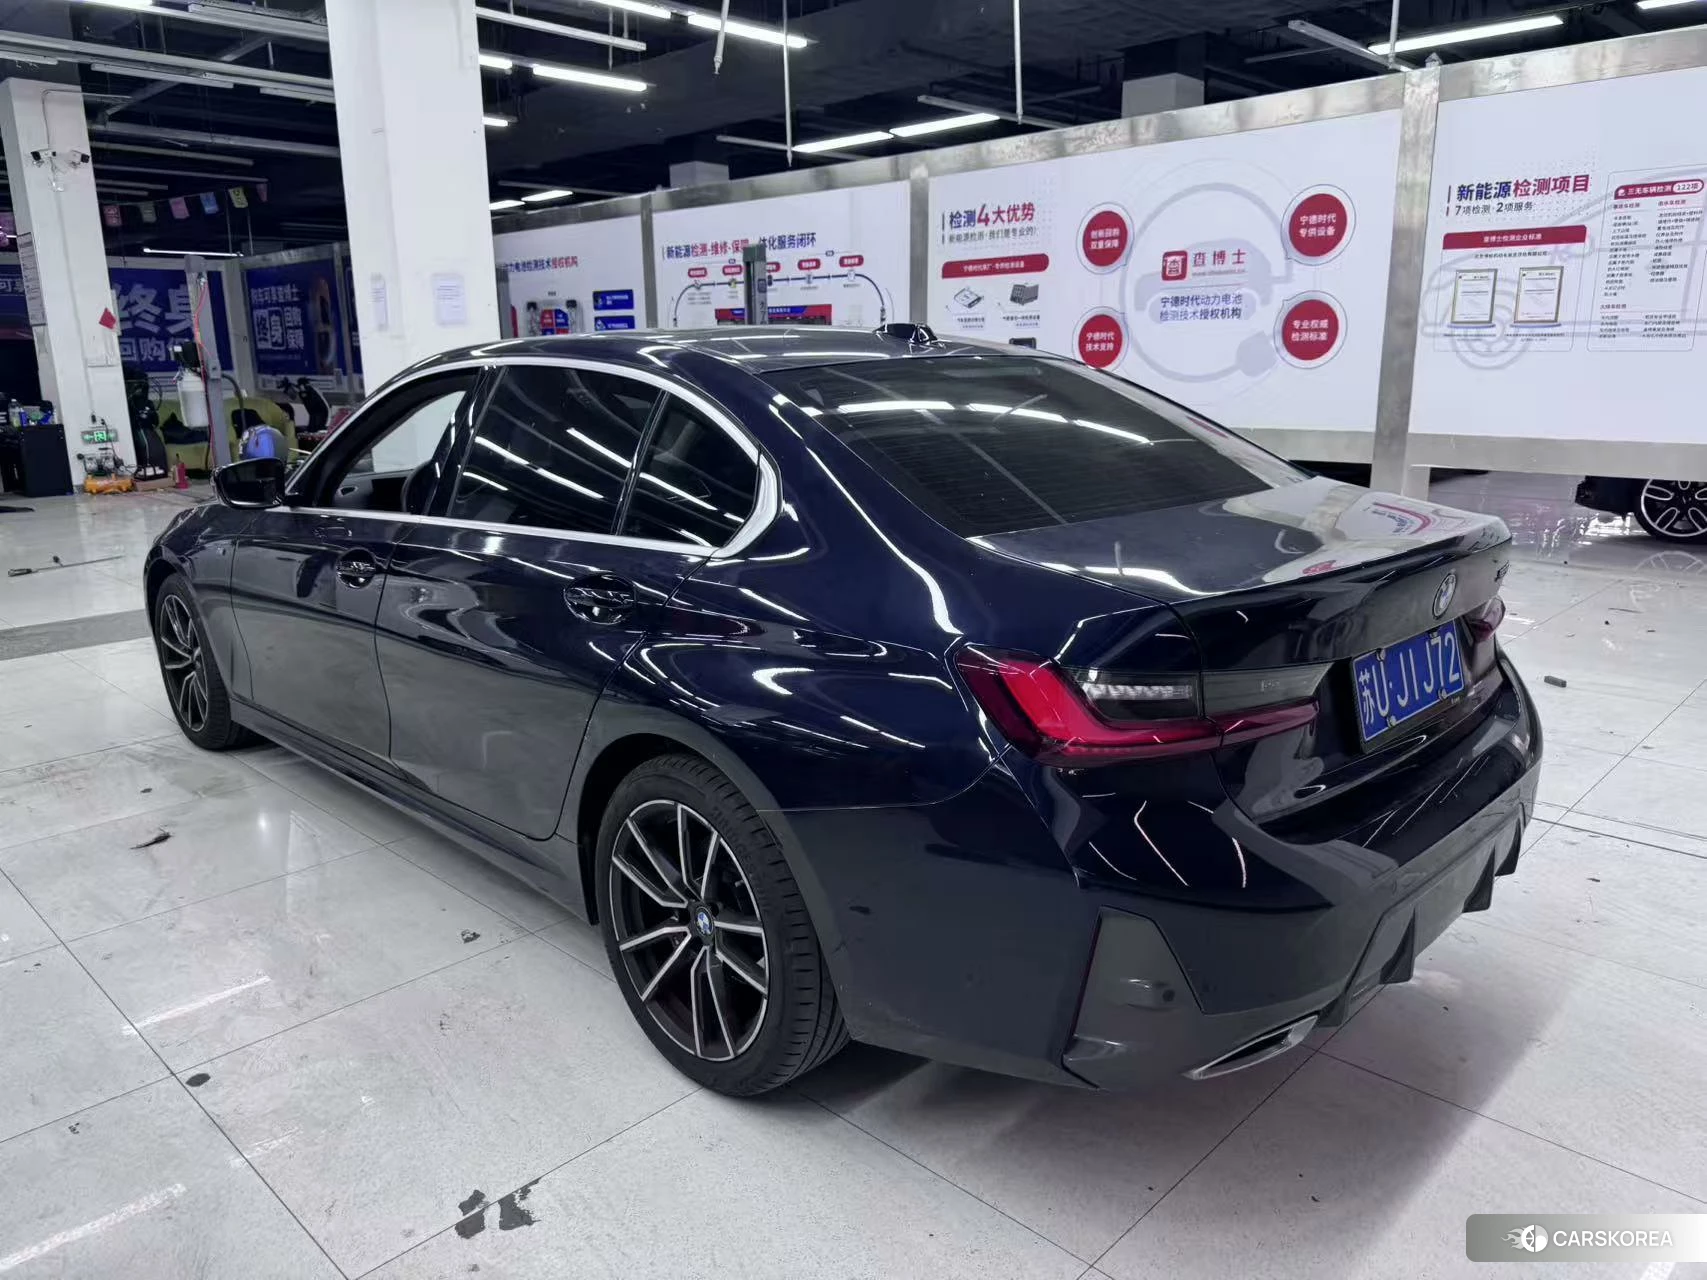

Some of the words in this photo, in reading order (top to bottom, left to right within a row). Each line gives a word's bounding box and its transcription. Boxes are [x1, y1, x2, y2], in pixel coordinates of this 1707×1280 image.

[1456, 174, 1590, 202] 新能源检测项目
[1676, 182, 1699, 191] 122项
[949, 202, 1035, 229] 检测4大优势
[1299, 213, 1337, 226] 宁德时代
[1298, 225, 1336, 238] 专供设备
[1160, 293, 1243, 308] 宁德时代动力电池
[1160, 307, 1242, 321] 检测技术授权机构
[1292, 319, 1329, 330] 专业权威
[1086, 331, 1115, 341] 宁德时代
[1291, 331, 1328, 342] 检测标准
[1085, 342, 1114, 352] 技术支持
